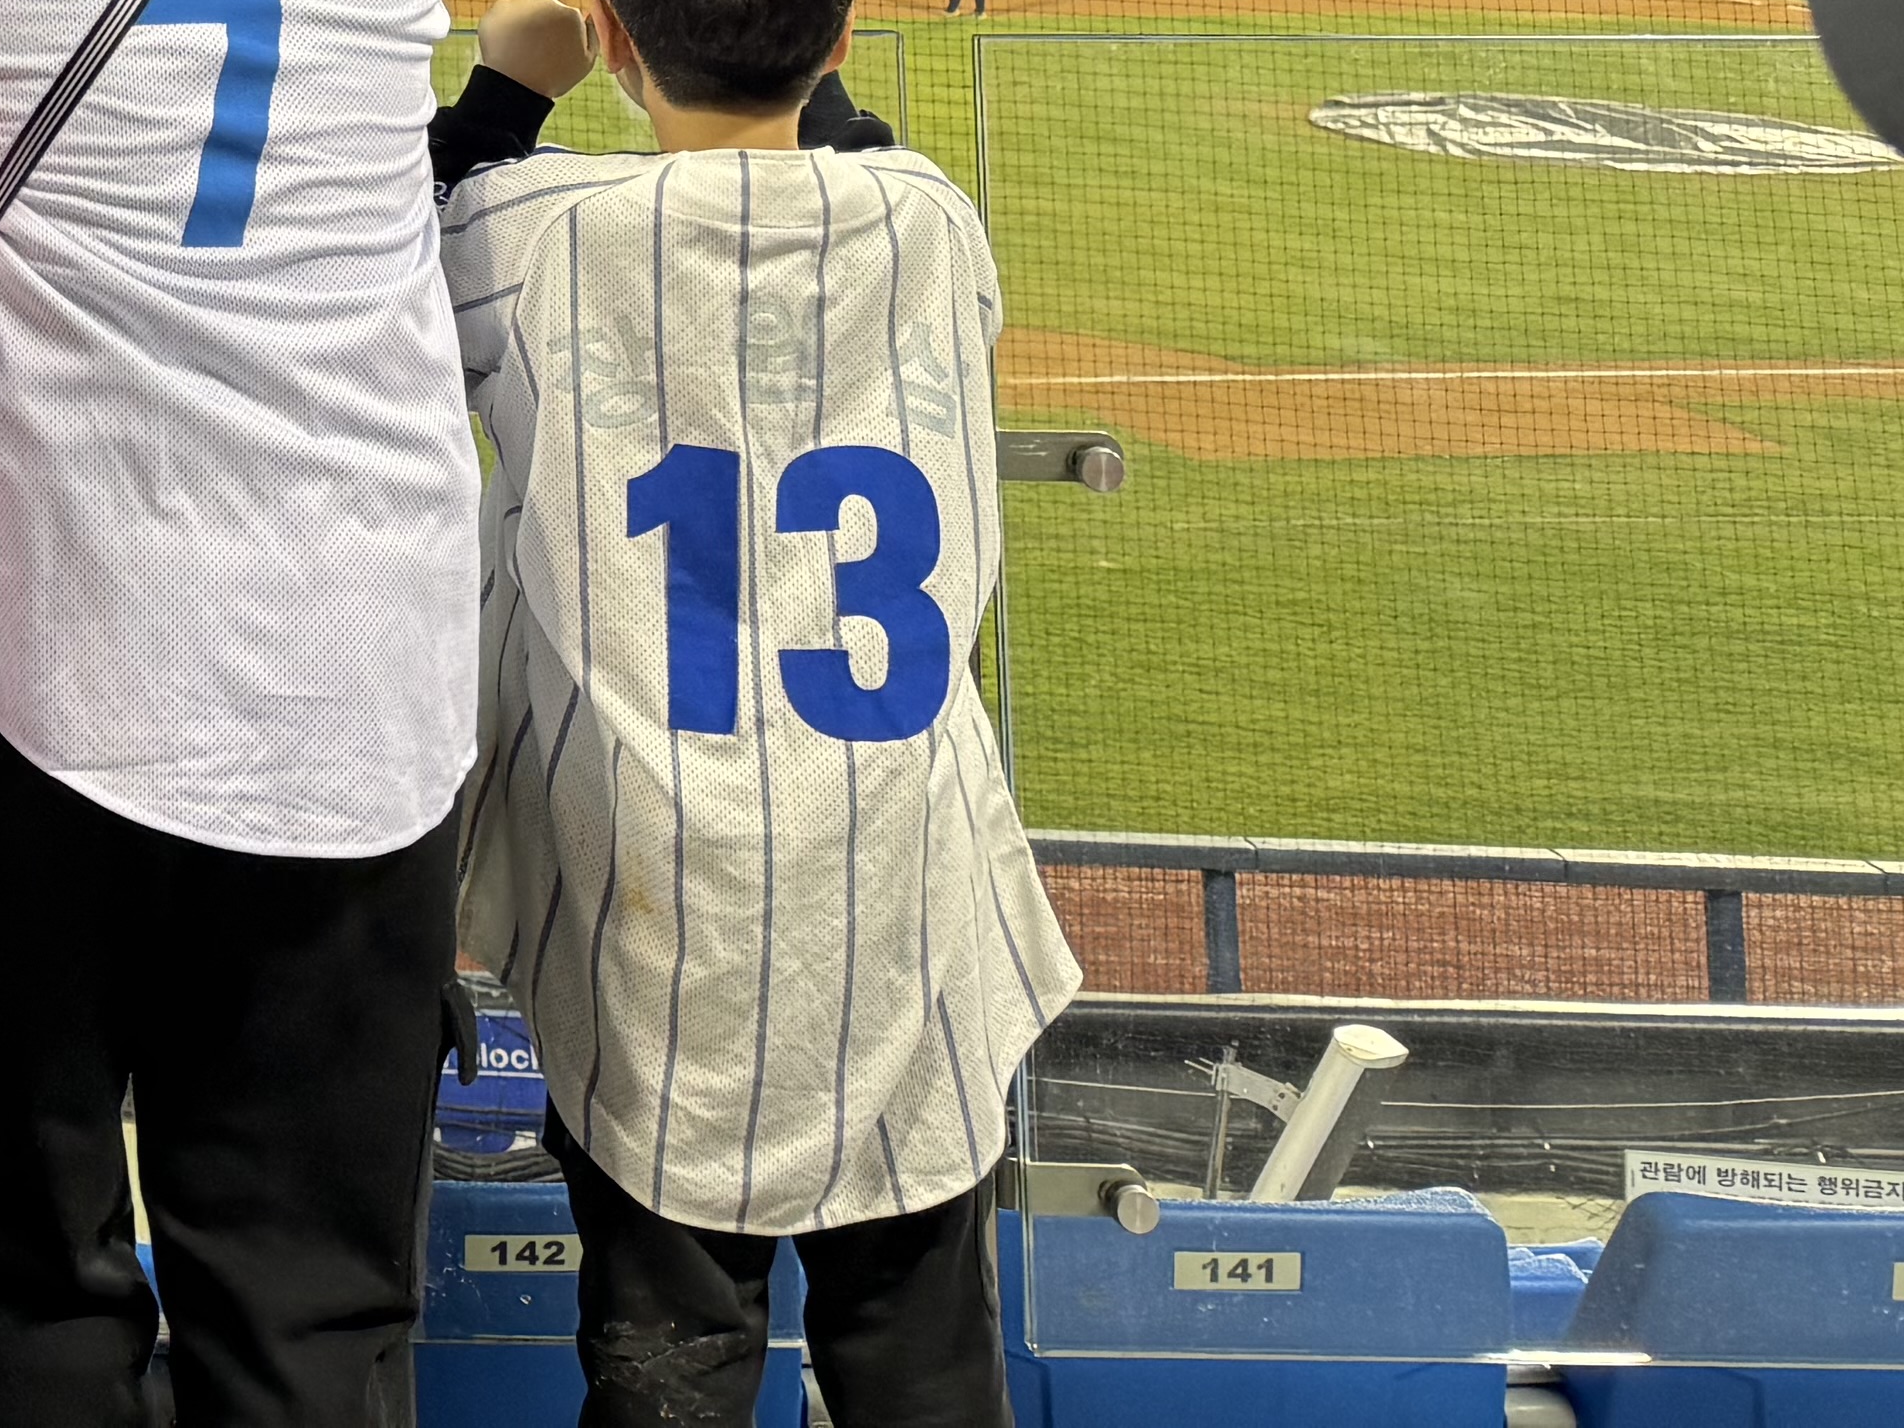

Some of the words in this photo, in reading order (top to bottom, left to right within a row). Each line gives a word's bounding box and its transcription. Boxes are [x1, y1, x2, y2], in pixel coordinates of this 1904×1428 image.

[625, 443, 951, 743] 13
[1639, 1160, 1707, 1186] 관람에
[1716, 1167, 1809, 1194] 방해되는
[489, 1239, 566, 1268] 142
[1200, 1256, 1277, 1286] 141
